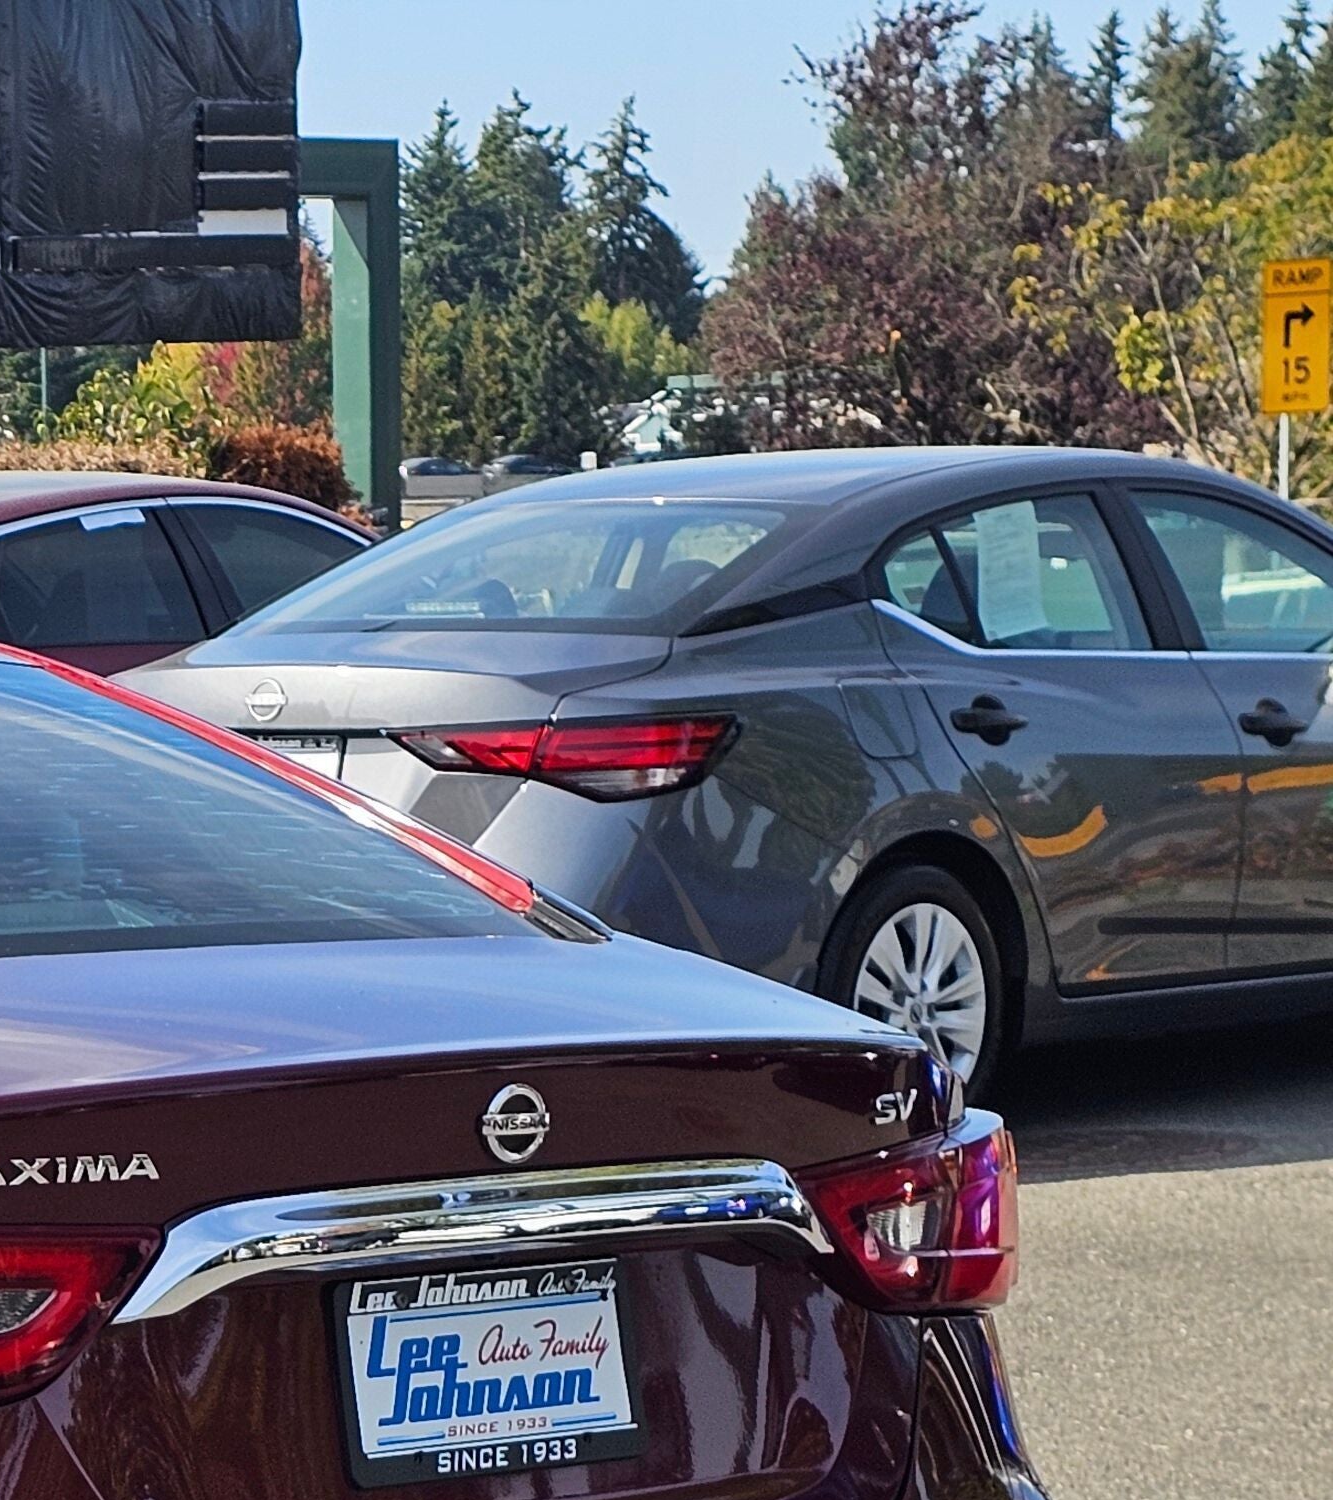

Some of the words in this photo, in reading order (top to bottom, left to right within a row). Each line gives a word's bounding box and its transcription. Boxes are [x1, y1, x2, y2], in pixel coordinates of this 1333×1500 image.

[1272, 267, 1324, 287] RAMP
[1283, 356, 1311, 385] 15
[492, 1114, 547, 1132] NISSAN
[874, 1088, 918, 1125] SV
[410, 1274, 530, 1308] Johnson
[537, 1271, 565, 1296] Aut
[366, 1315, 468, 1378] Lee
[478, 1324, 533, 1367] Auto
[534, 1315, 610, 1368] Family
[378, 1362, 601, 1427] Johnson
[447, 1421, 499, 1438] SINCE
[508, 1416, 548, 1431] 1933
[437, 1446, 509, 1474] SINCE
[521, 1438, 577, 1465] 1933
